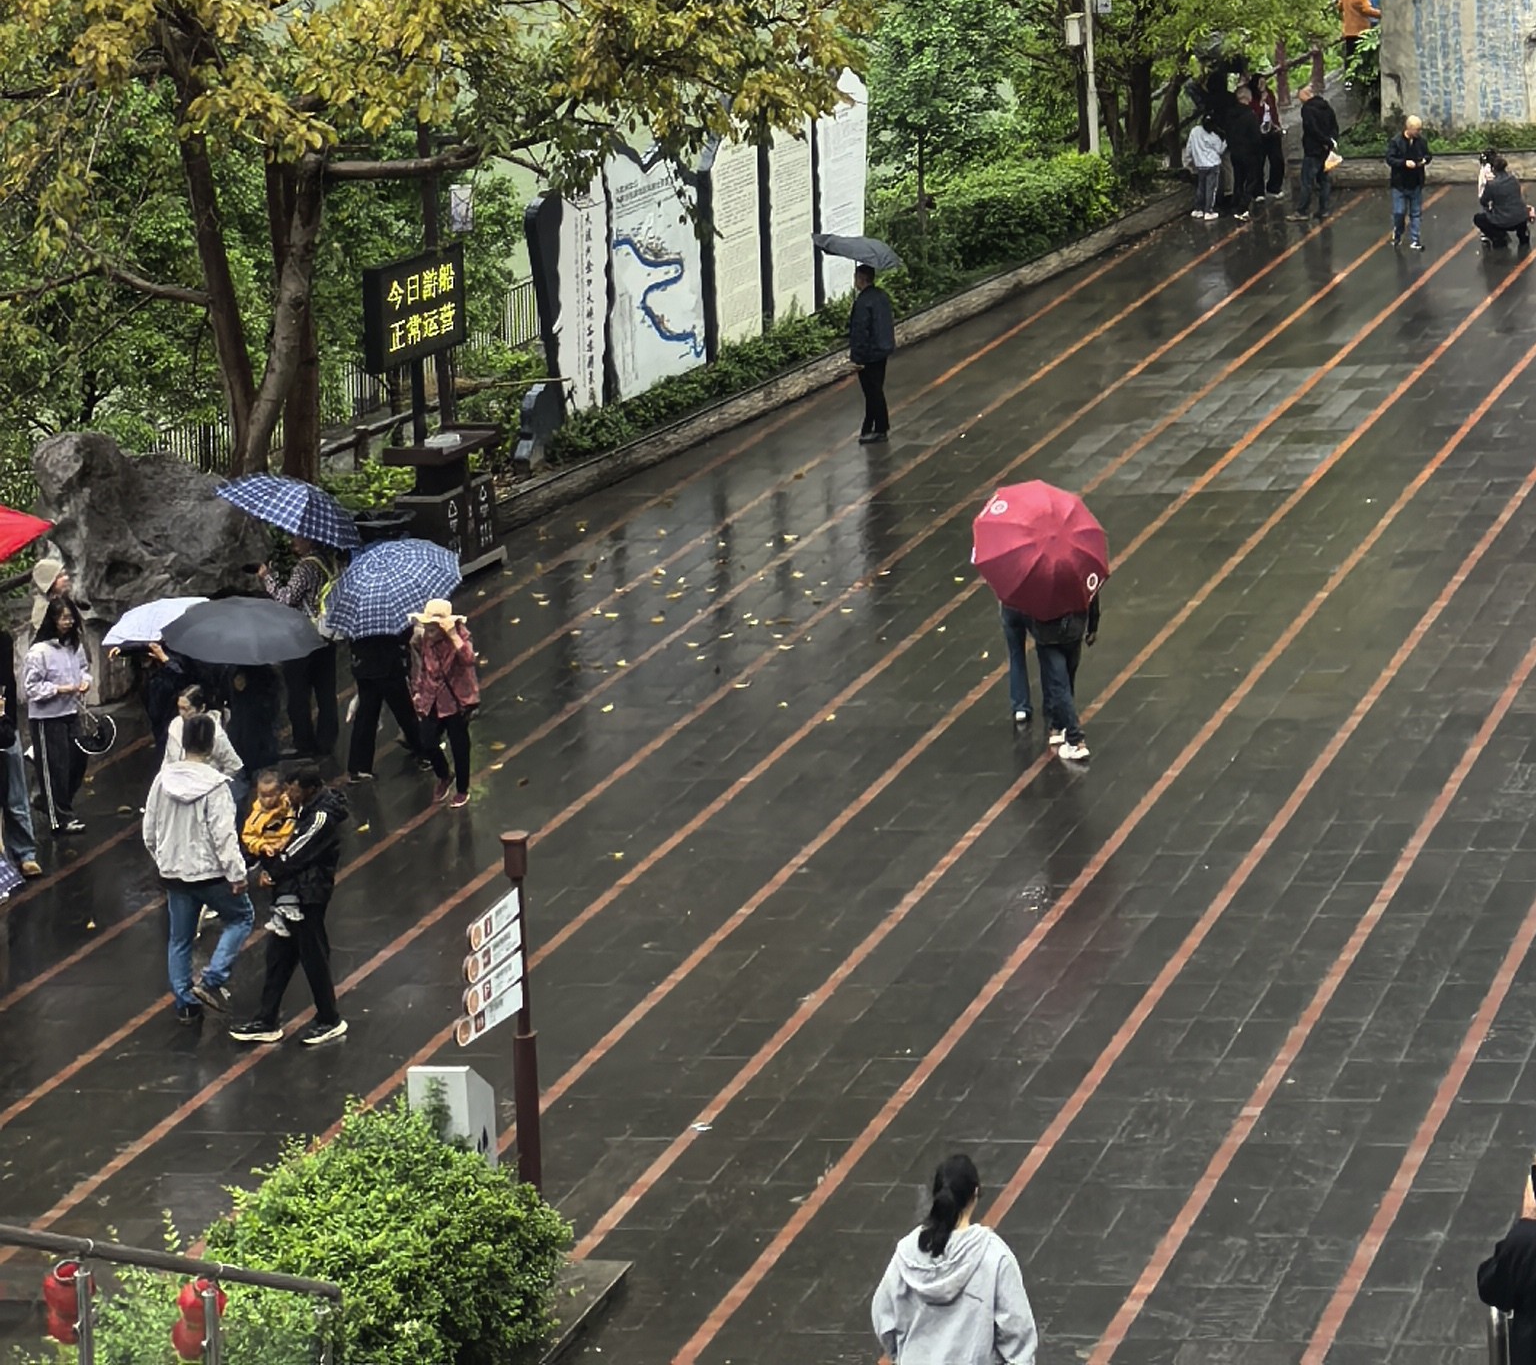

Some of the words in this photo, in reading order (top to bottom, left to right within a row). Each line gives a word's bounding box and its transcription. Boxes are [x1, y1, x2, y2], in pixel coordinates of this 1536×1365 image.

[386, 262, 456, 311] 今日游船
[389, 301, 456, 353] 正常运营
